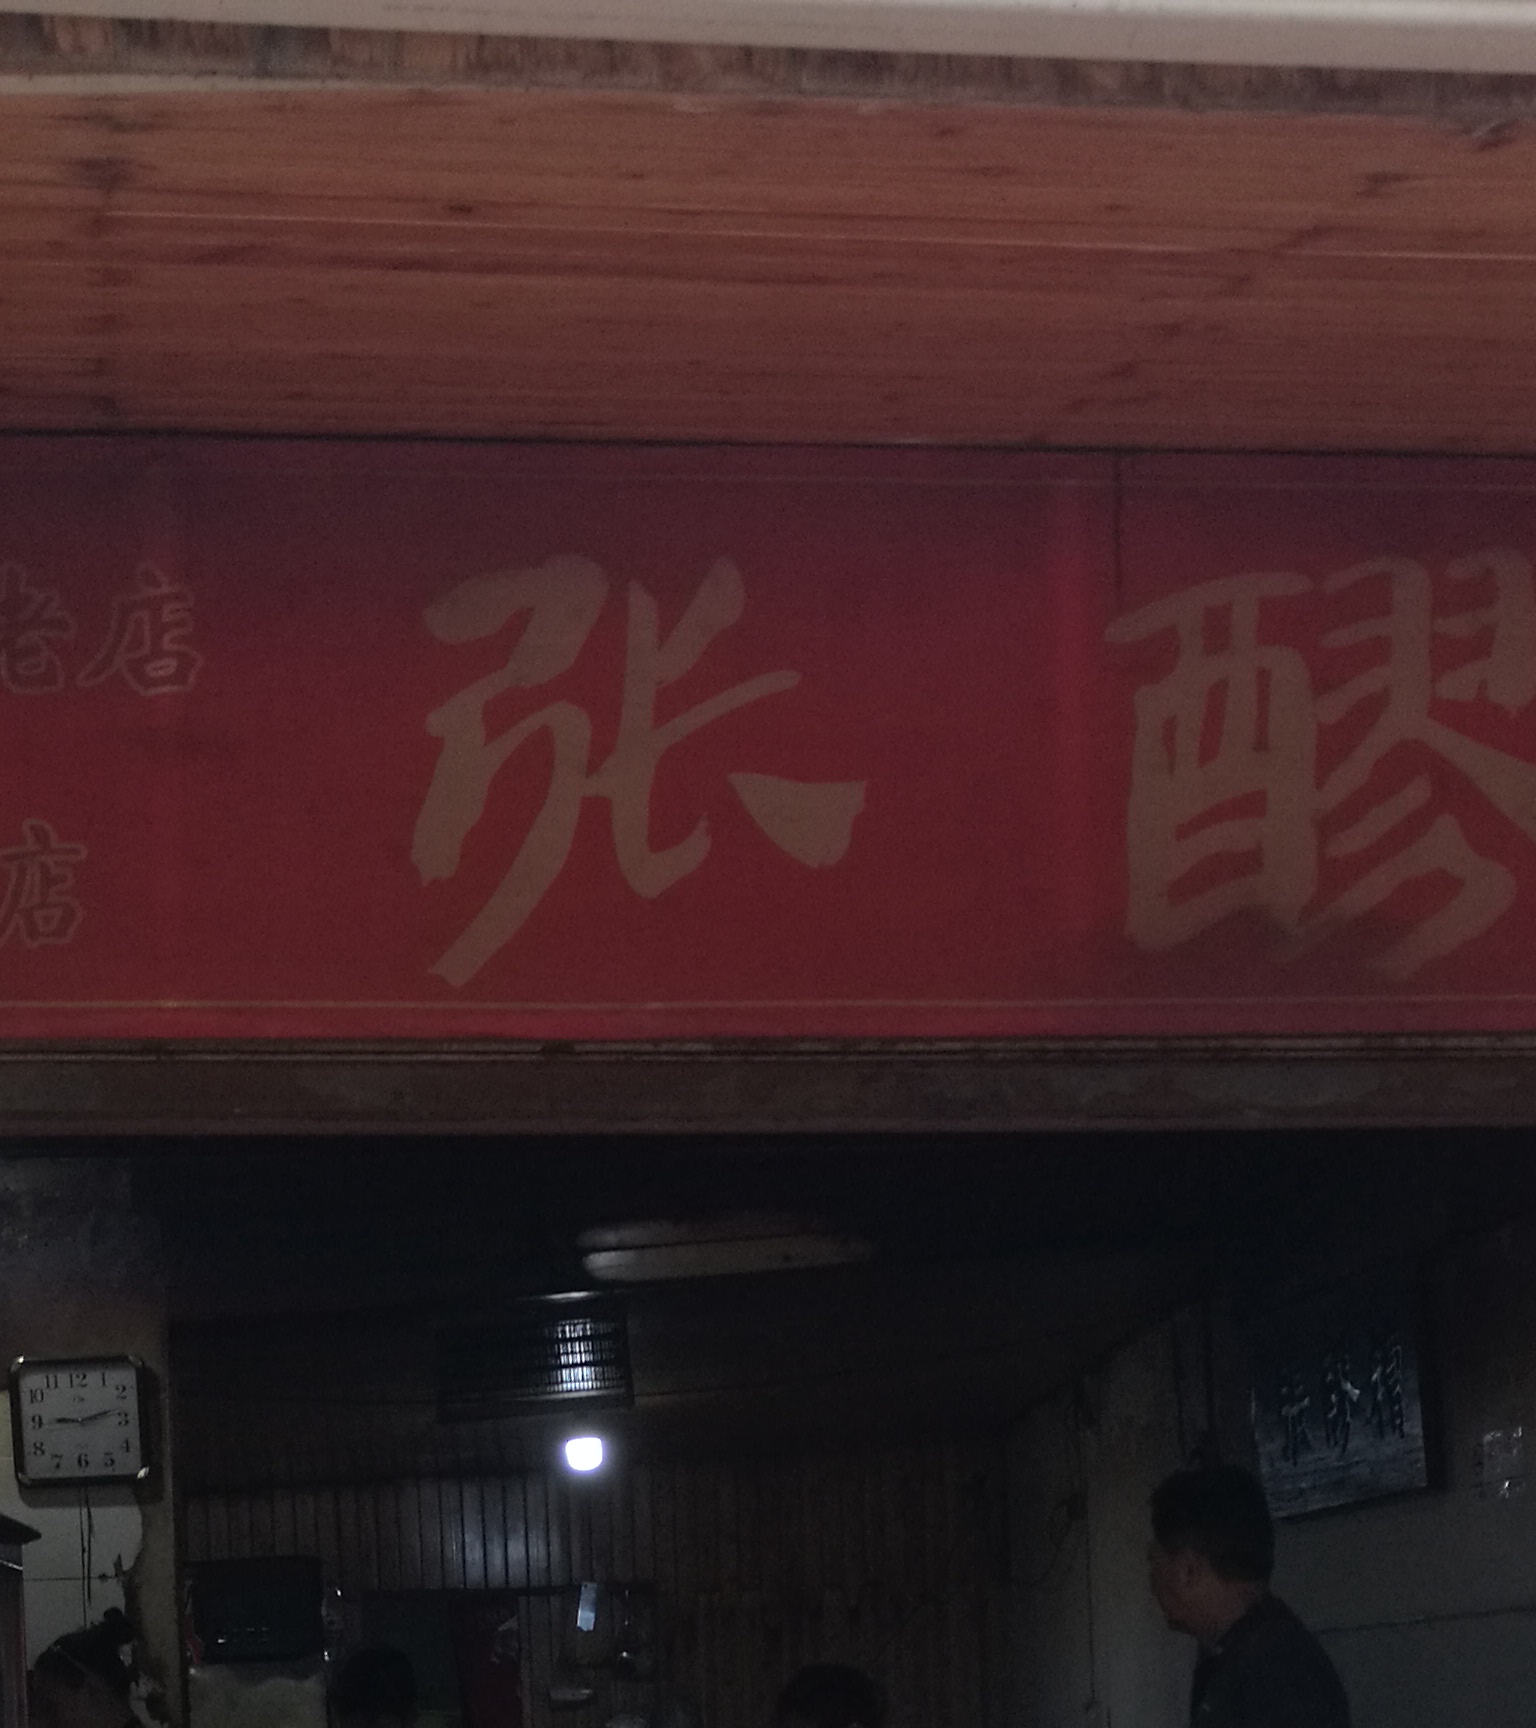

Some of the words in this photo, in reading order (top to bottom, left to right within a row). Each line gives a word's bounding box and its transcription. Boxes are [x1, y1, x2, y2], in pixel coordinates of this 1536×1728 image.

[46, 1375, 59, 1389] 11
[69, 1372, 89, 1388] 12
[30, 1389, 44, 1404] 10
[116, 1384, 128, 1400] 2
[32, 1415, 43, 1429] 9
[118, 1412, 129, 1426] 3
[34, 1442, 45, 1456] 8
[119, 1437, 130, 1453] 4
[52, 1455, 63, 1469] 7
[77, 1454, 89, 1469] 6
[104, 1453, 115, 1469] 5
